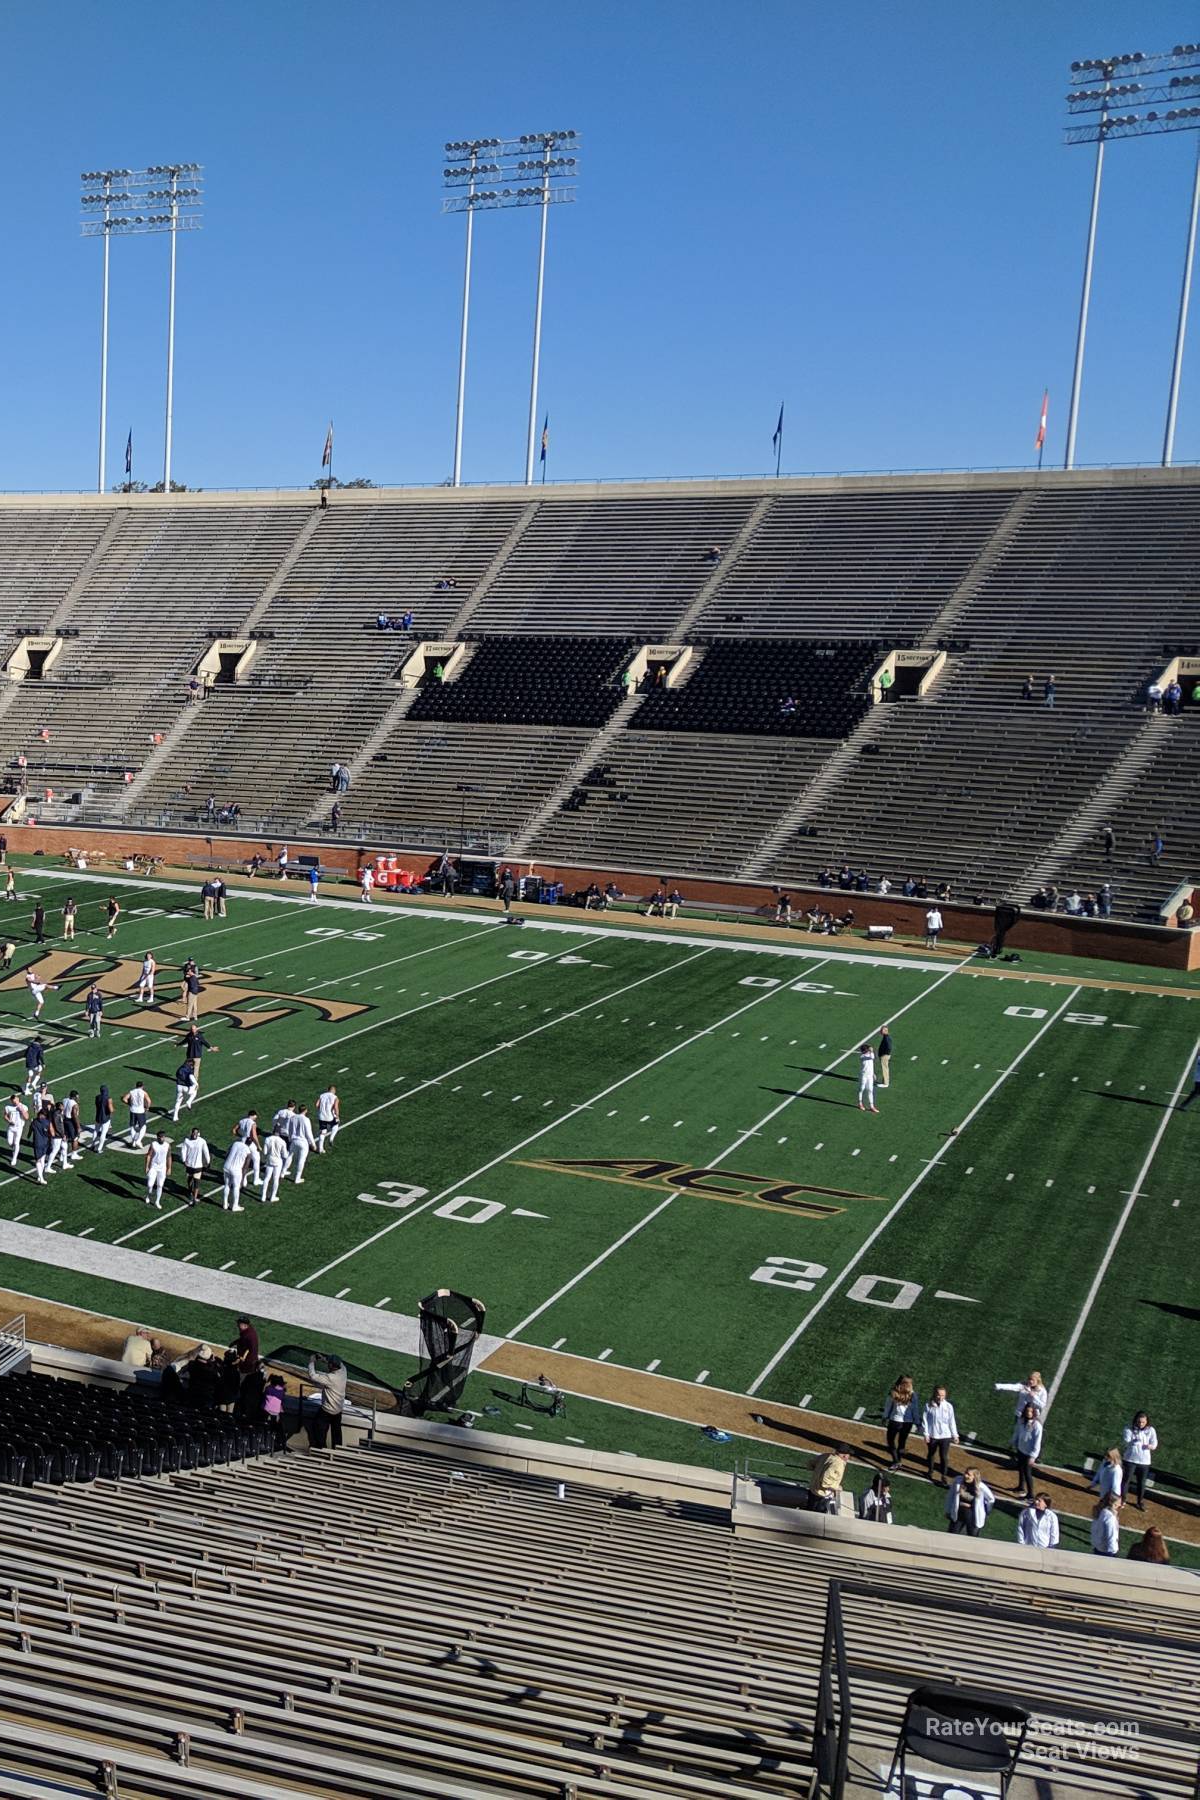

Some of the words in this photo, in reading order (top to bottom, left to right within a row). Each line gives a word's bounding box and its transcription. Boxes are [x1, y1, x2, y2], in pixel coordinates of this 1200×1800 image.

[738, 976, 835, 995] 30
[1003, 1005, 1108, 1026] 20
[356, 1181, 506, 1224] 30
[530, 1158, 890, 1216] ACC
[749, 1256, 924, 1311] 20
